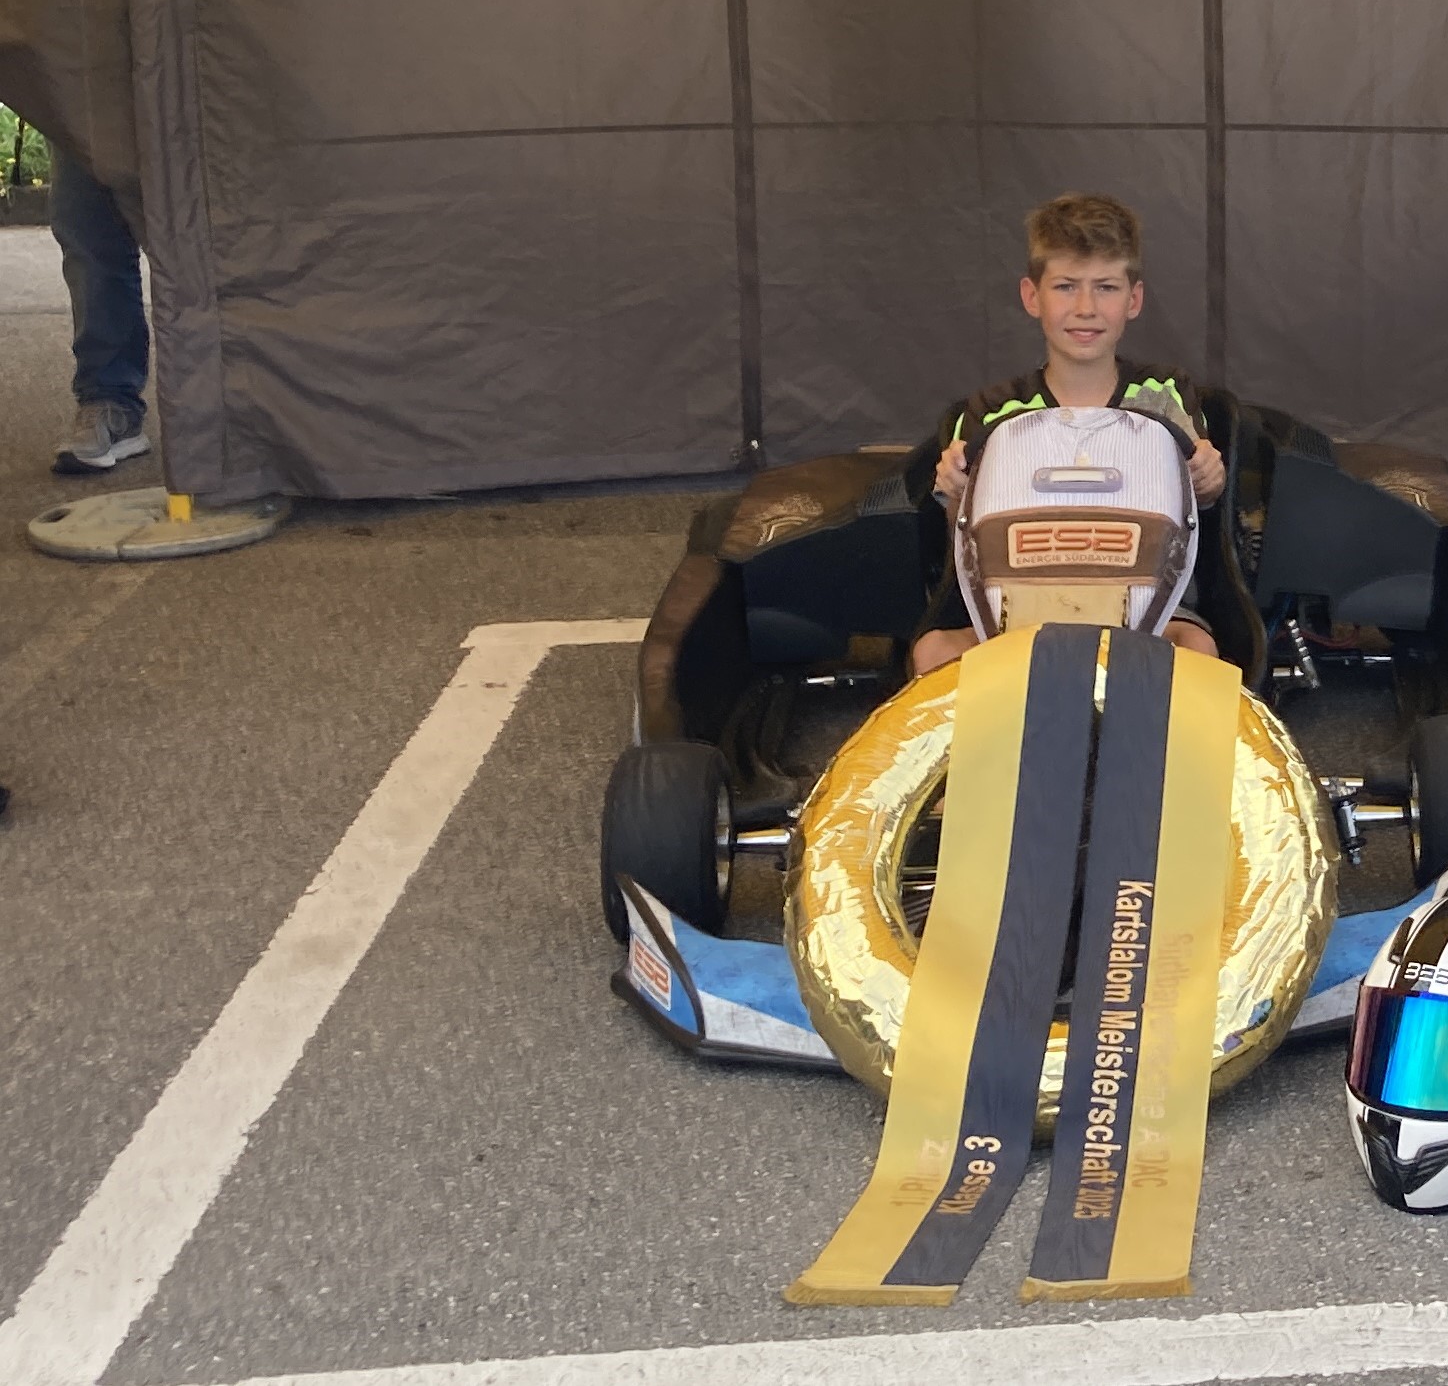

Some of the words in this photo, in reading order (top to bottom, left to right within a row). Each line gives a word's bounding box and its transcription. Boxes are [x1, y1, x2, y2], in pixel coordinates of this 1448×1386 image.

[1015, 527, 1133, 554] ESB
[1016, 553, 1061, 566] ENERGIE
[1103, 880, 1154, 1003] Kartslalom
[1080, 1010, 1138, 1185] Meisterschaft
[964, 1135, 1002, 1153] 3
[935, 1159, 997, 1215] Klasse
